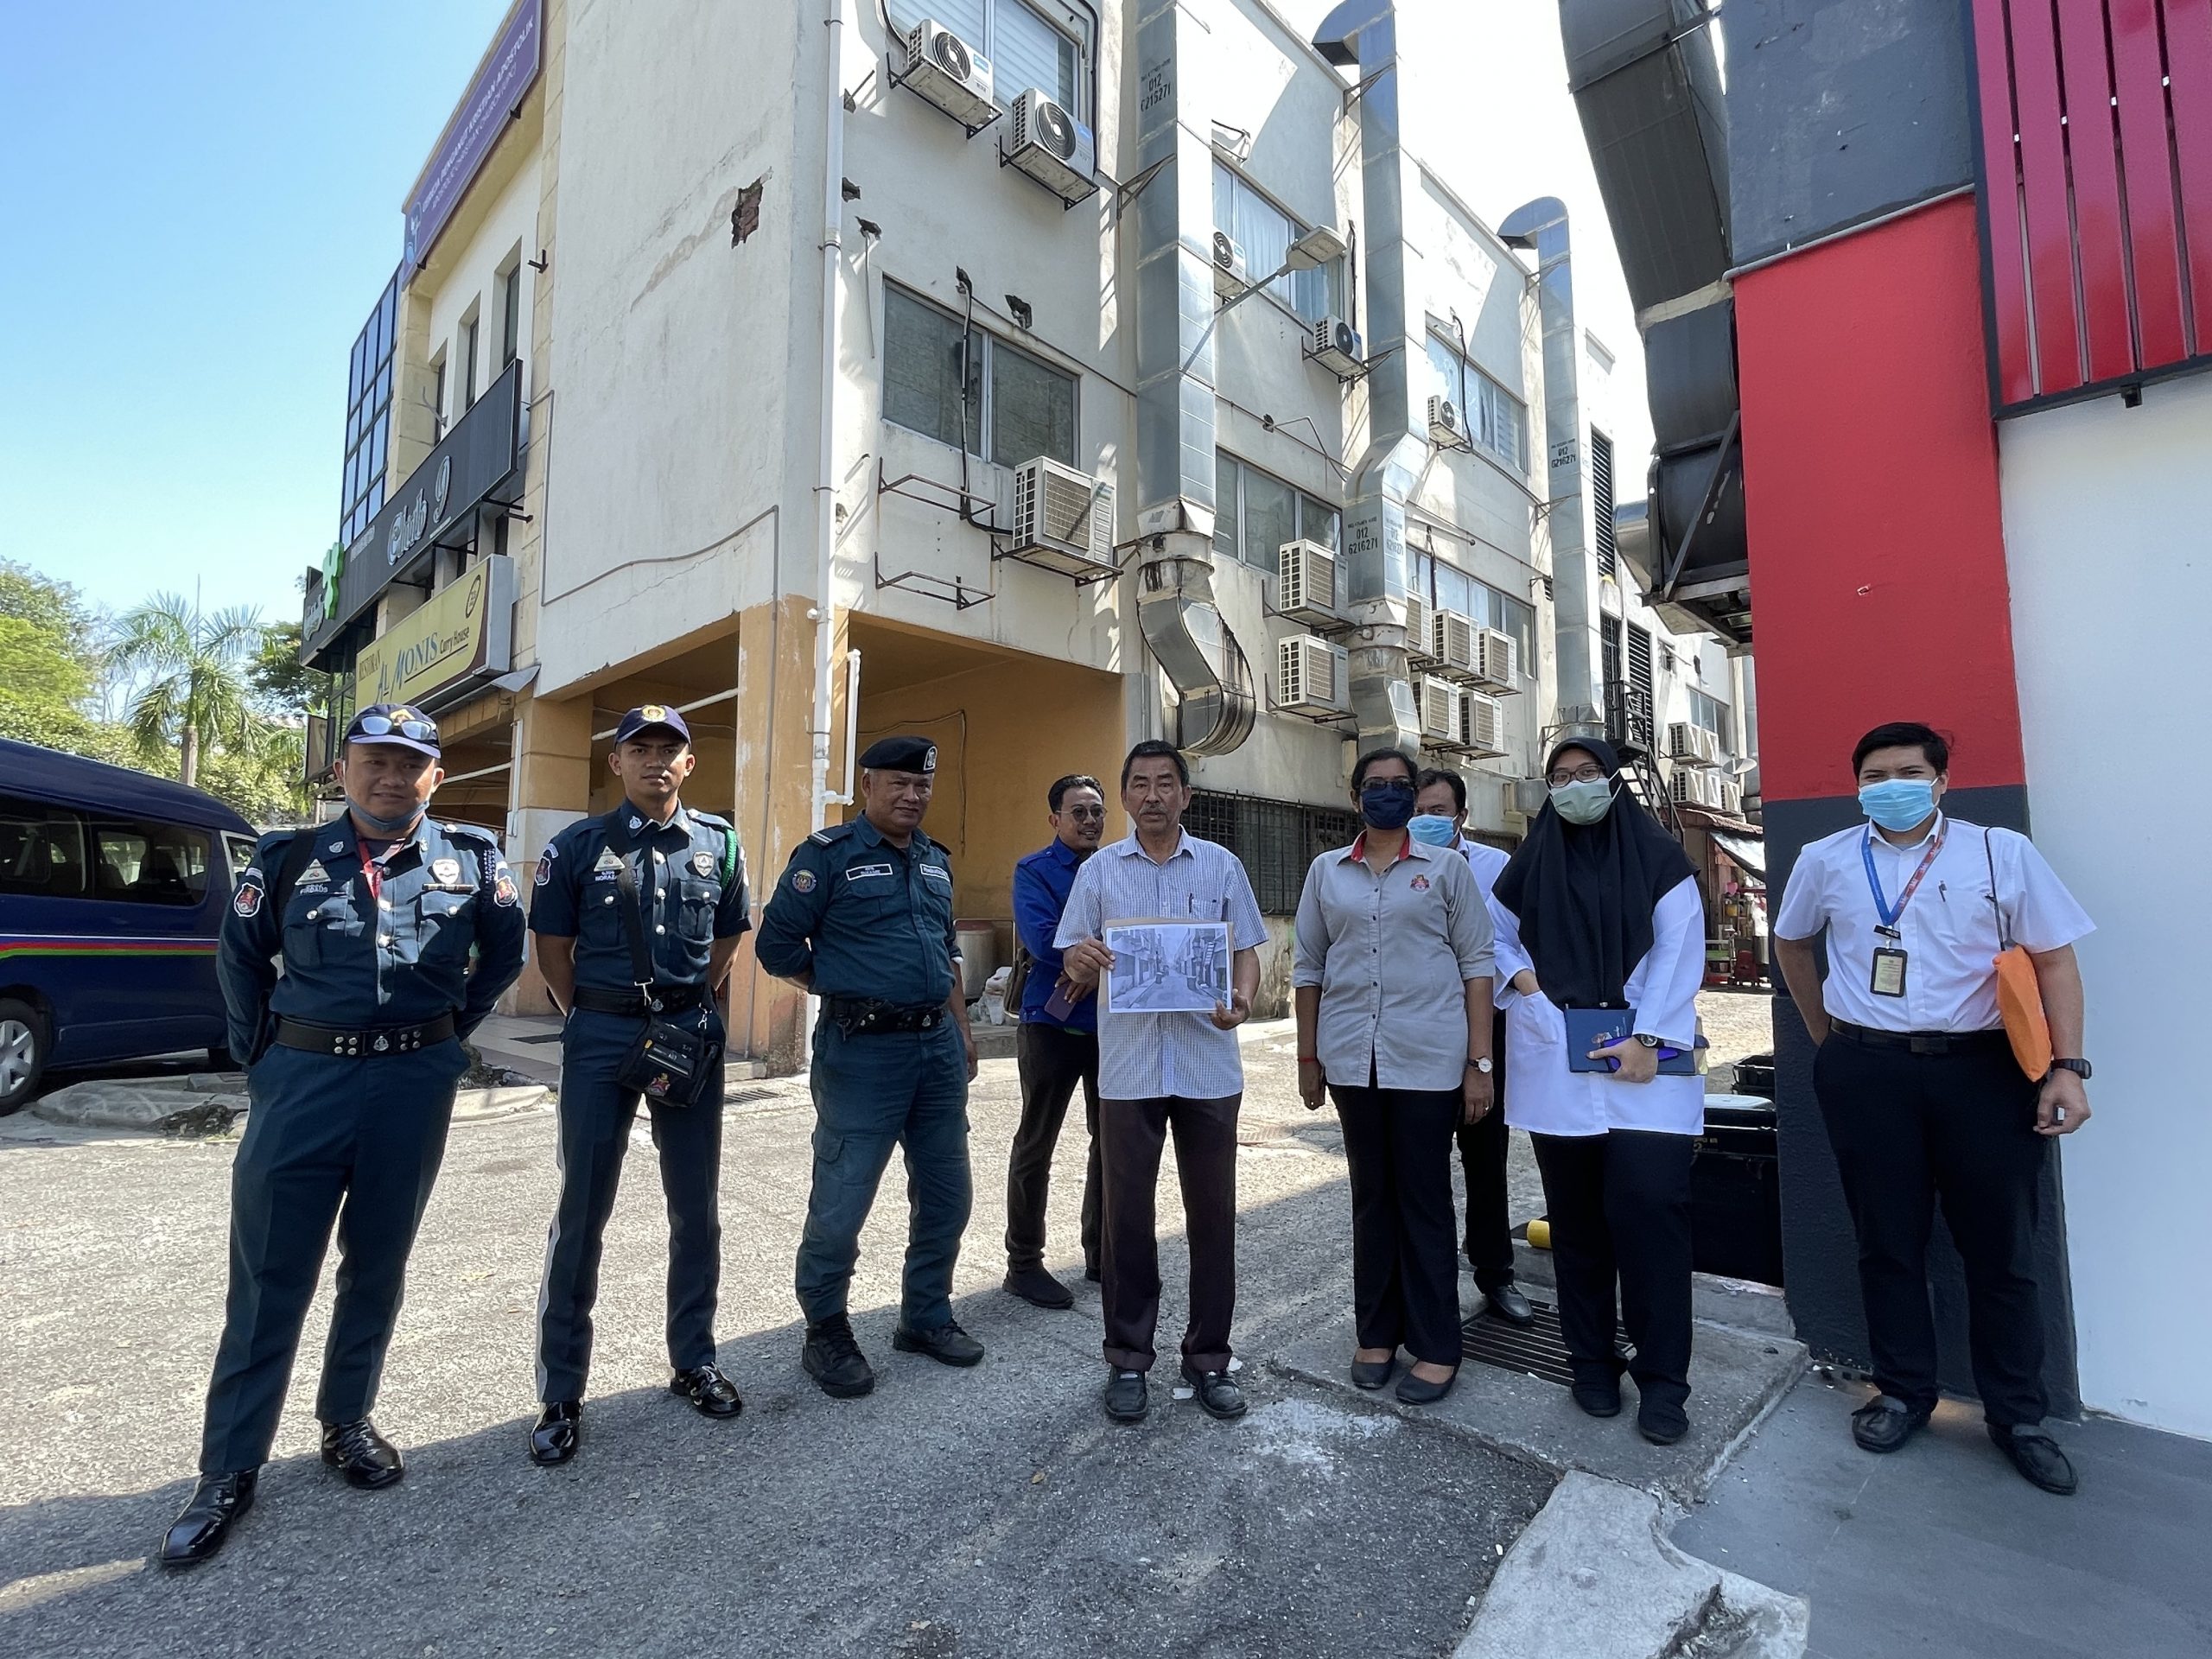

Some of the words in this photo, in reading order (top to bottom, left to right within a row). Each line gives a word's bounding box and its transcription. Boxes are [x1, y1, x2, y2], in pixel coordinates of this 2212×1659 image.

[1148, 73, 1162, 92] 012
[1558, 446, 1568, 457] 012
[387, 487, 428, 566] Club
[1356, 526, 1369, 539] 012
[1348, 537, 1378, 555] 6216271
[374, 661, 390, 704] AL
[390, 632, 437, 701] MONIS
[439, 633, 453, 655] Curry
[453, 626, 470, 646] House
